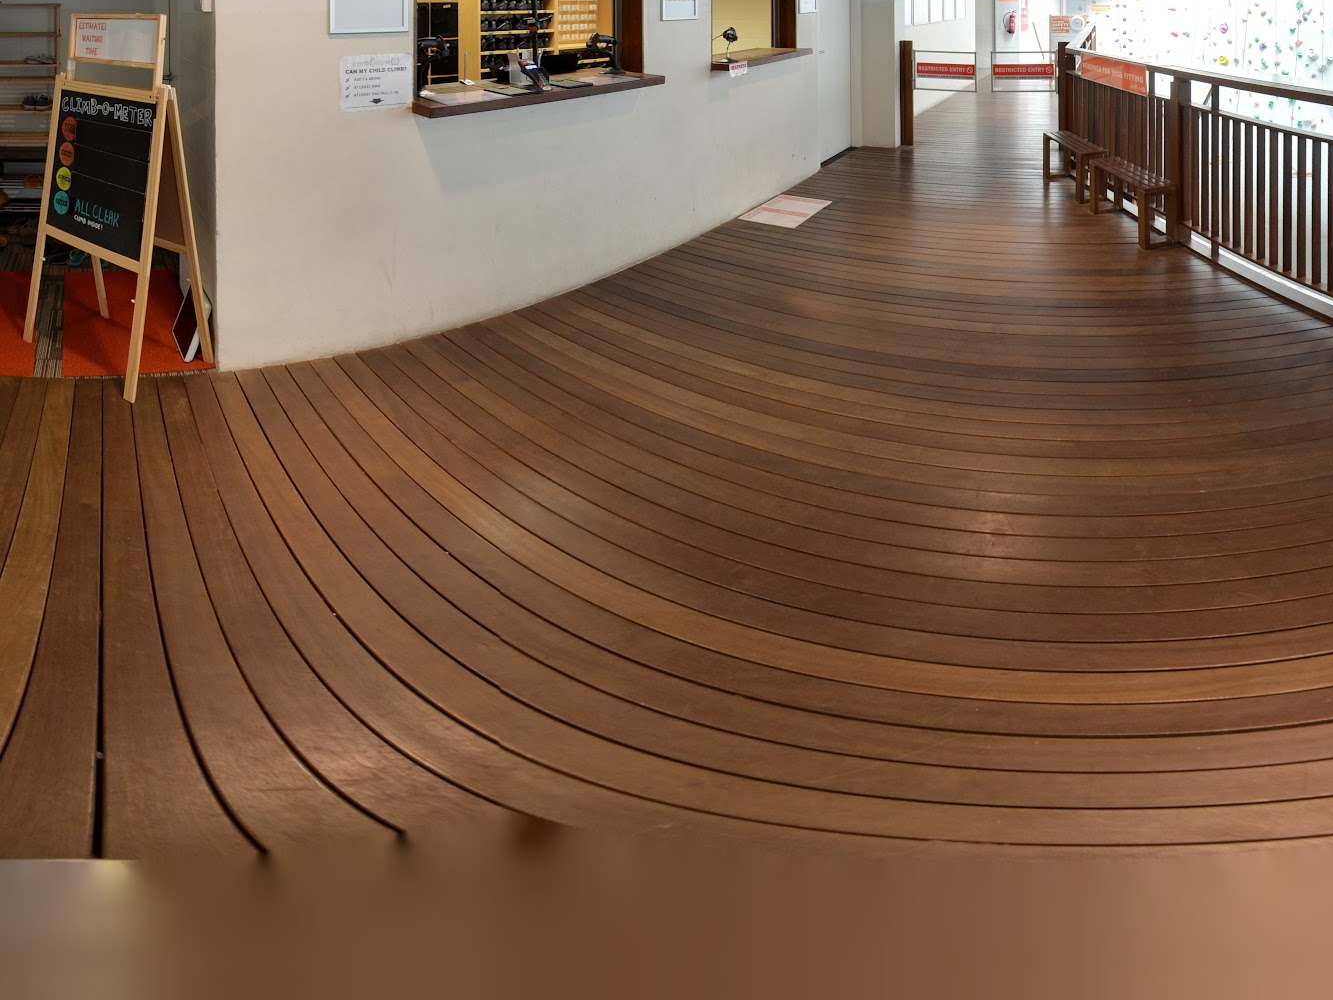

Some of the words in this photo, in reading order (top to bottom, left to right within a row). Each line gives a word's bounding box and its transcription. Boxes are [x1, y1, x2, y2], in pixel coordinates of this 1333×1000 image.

[82, 34, 103, 43] WAITING
[85, 47, 98, 55] TIME
[1083, 62, 1101, 73] RESERVED
[1102, 66, 1111, 75] FOR
[1111, 69, 1123, 79] SHOE
[1124, 72, 1143, 83] FITTING
[61, 96, 153, 127] CLIMB-O-METER
[73, 214, 87, 225] CLIMB
[74, 197, 90, 217] ALL
[92, 204, 120, 228] CLEAR
